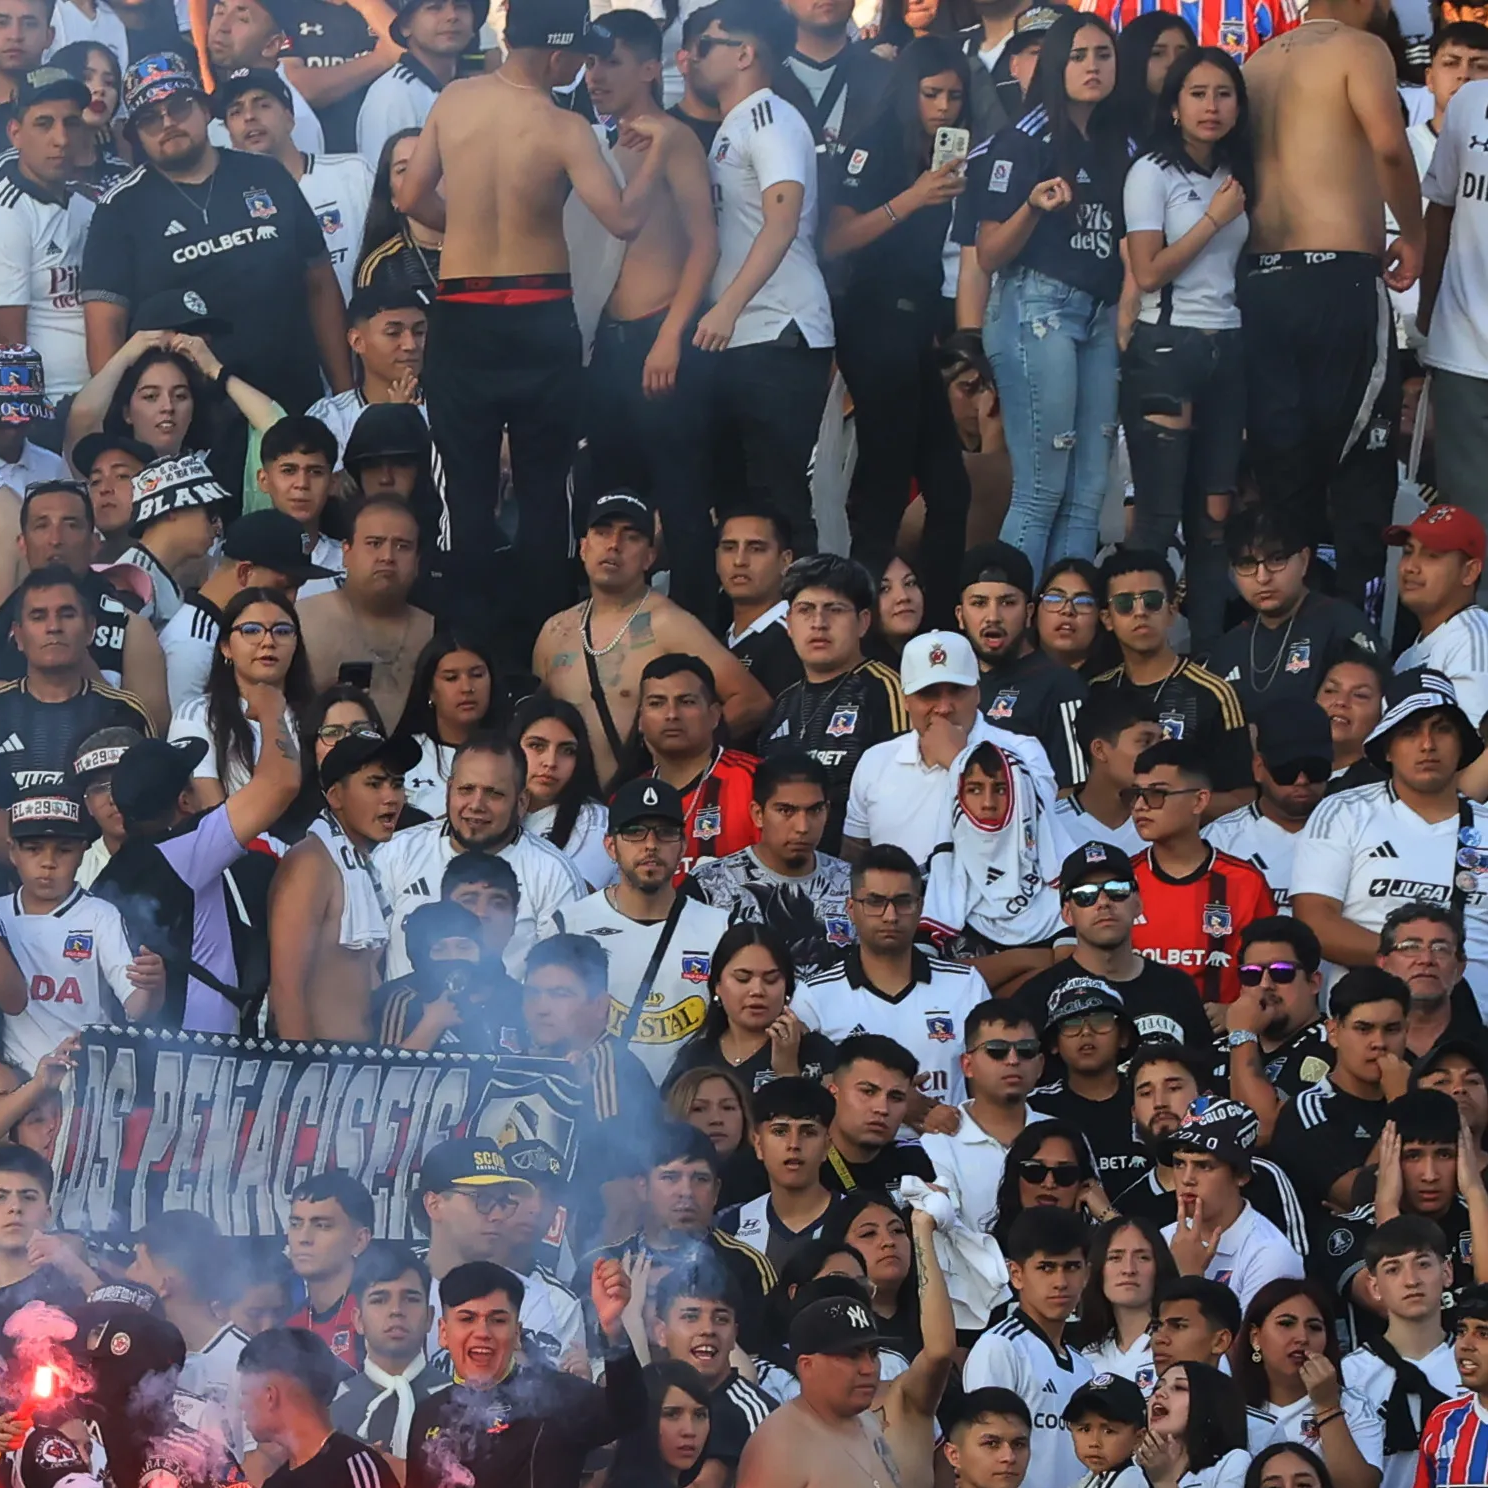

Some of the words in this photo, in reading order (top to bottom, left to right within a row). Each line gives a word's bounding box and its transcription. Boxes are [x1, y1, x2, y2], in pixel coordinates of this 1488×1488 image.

[172, 226, 255, 264] COOLBET
[1258, 254, 1282, 267] TOP
[1303, 251, 1337, 265] TOP
[33, 799, 50, 816] 29
